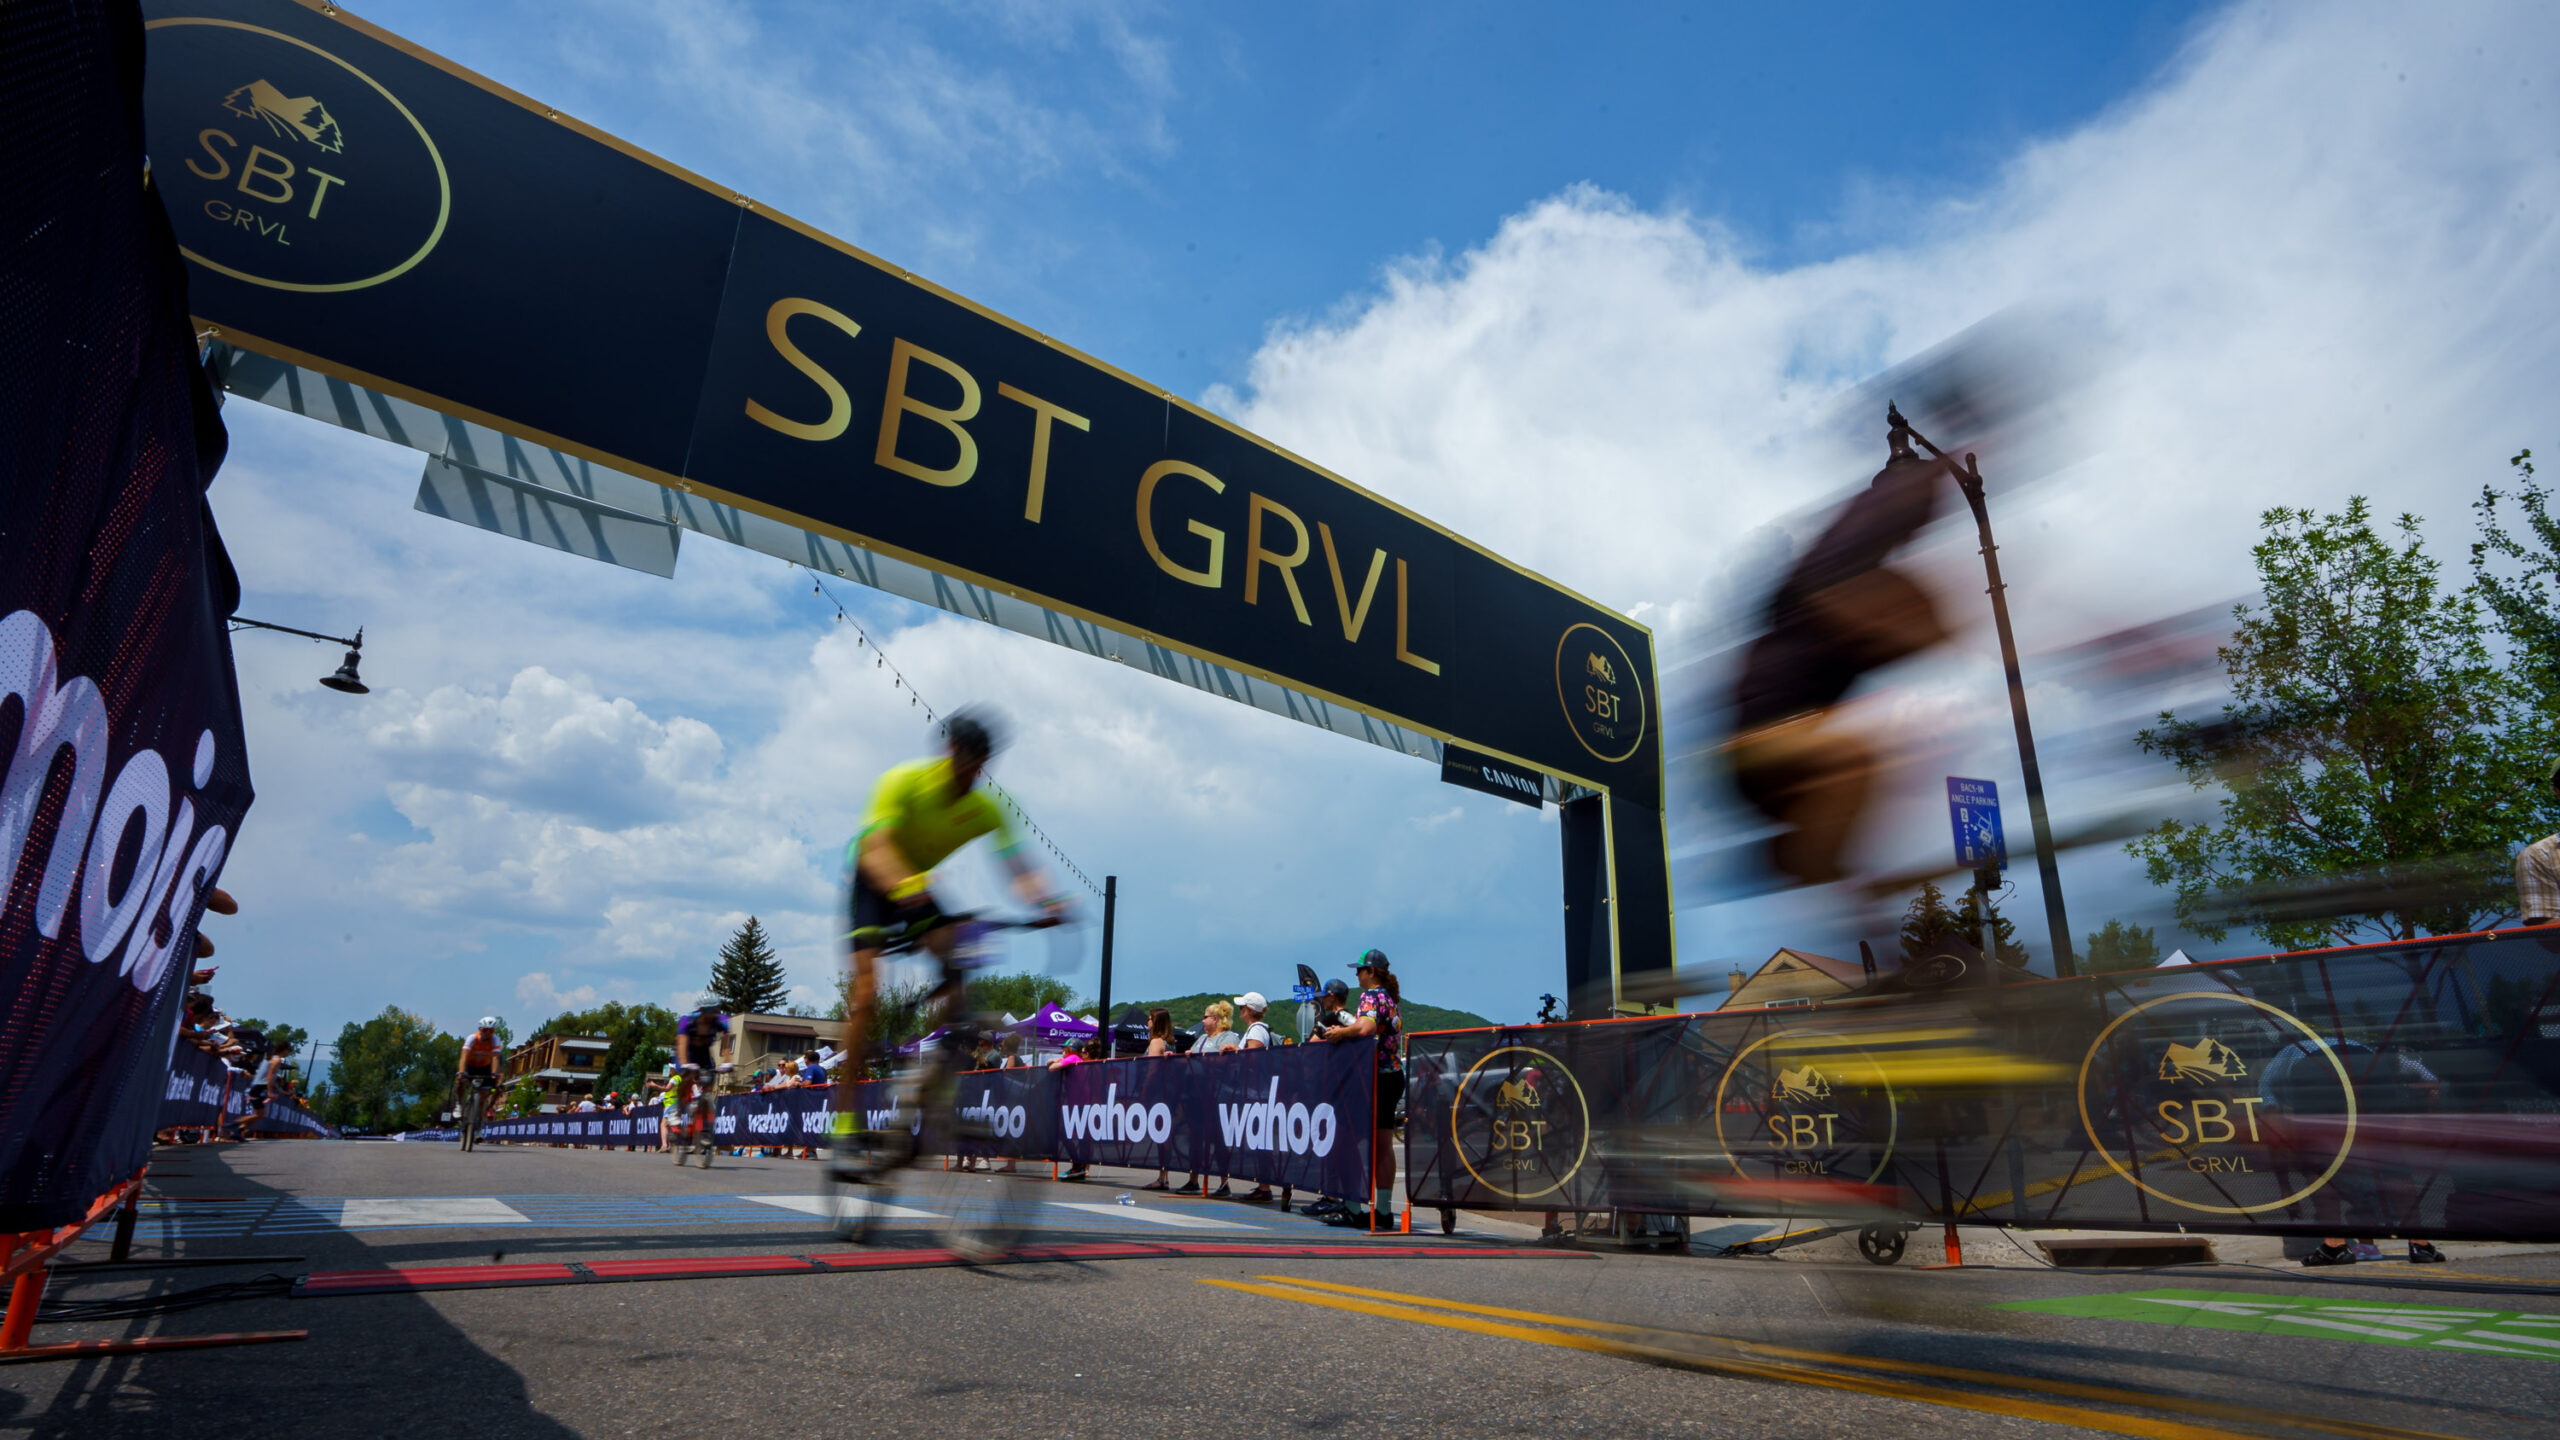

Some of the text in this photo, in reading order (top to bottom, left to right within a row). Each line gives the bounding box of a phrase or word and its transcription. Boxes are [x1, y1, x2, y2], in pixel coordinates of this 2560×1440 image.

[184, 128, 346, 220] SBT
[204, 199, 290, 246] GRVL
[745, 297, 1441, 677] SBT GRVL
[1585, 684, 1620, 722] SBT
[1592, 722, 1615, 739] GRVL
[1482, 766, 1540, 797] CANYON
[1960, 782, 1984, 793] BACK-IN
[1951, 793, 1997, 807] ANGLE PARKING
[748, 1103, 789, 1134] wahoo
[1062, 1083, 1172, 1144] wahoo
[1217, 1075, 1337, 1158] wahoo
[2158, 1097, 2263, 1143] SBT
[1491, 1119, 1547, 1151] SBT
[1768, 1113, 1839, 1150] SBT
[1503, 1158, 1536, 1171] GRVL
[1784, 1160, 1829, 1175] GRVL
[2187, 1156, 2254, 1173] GRVL
